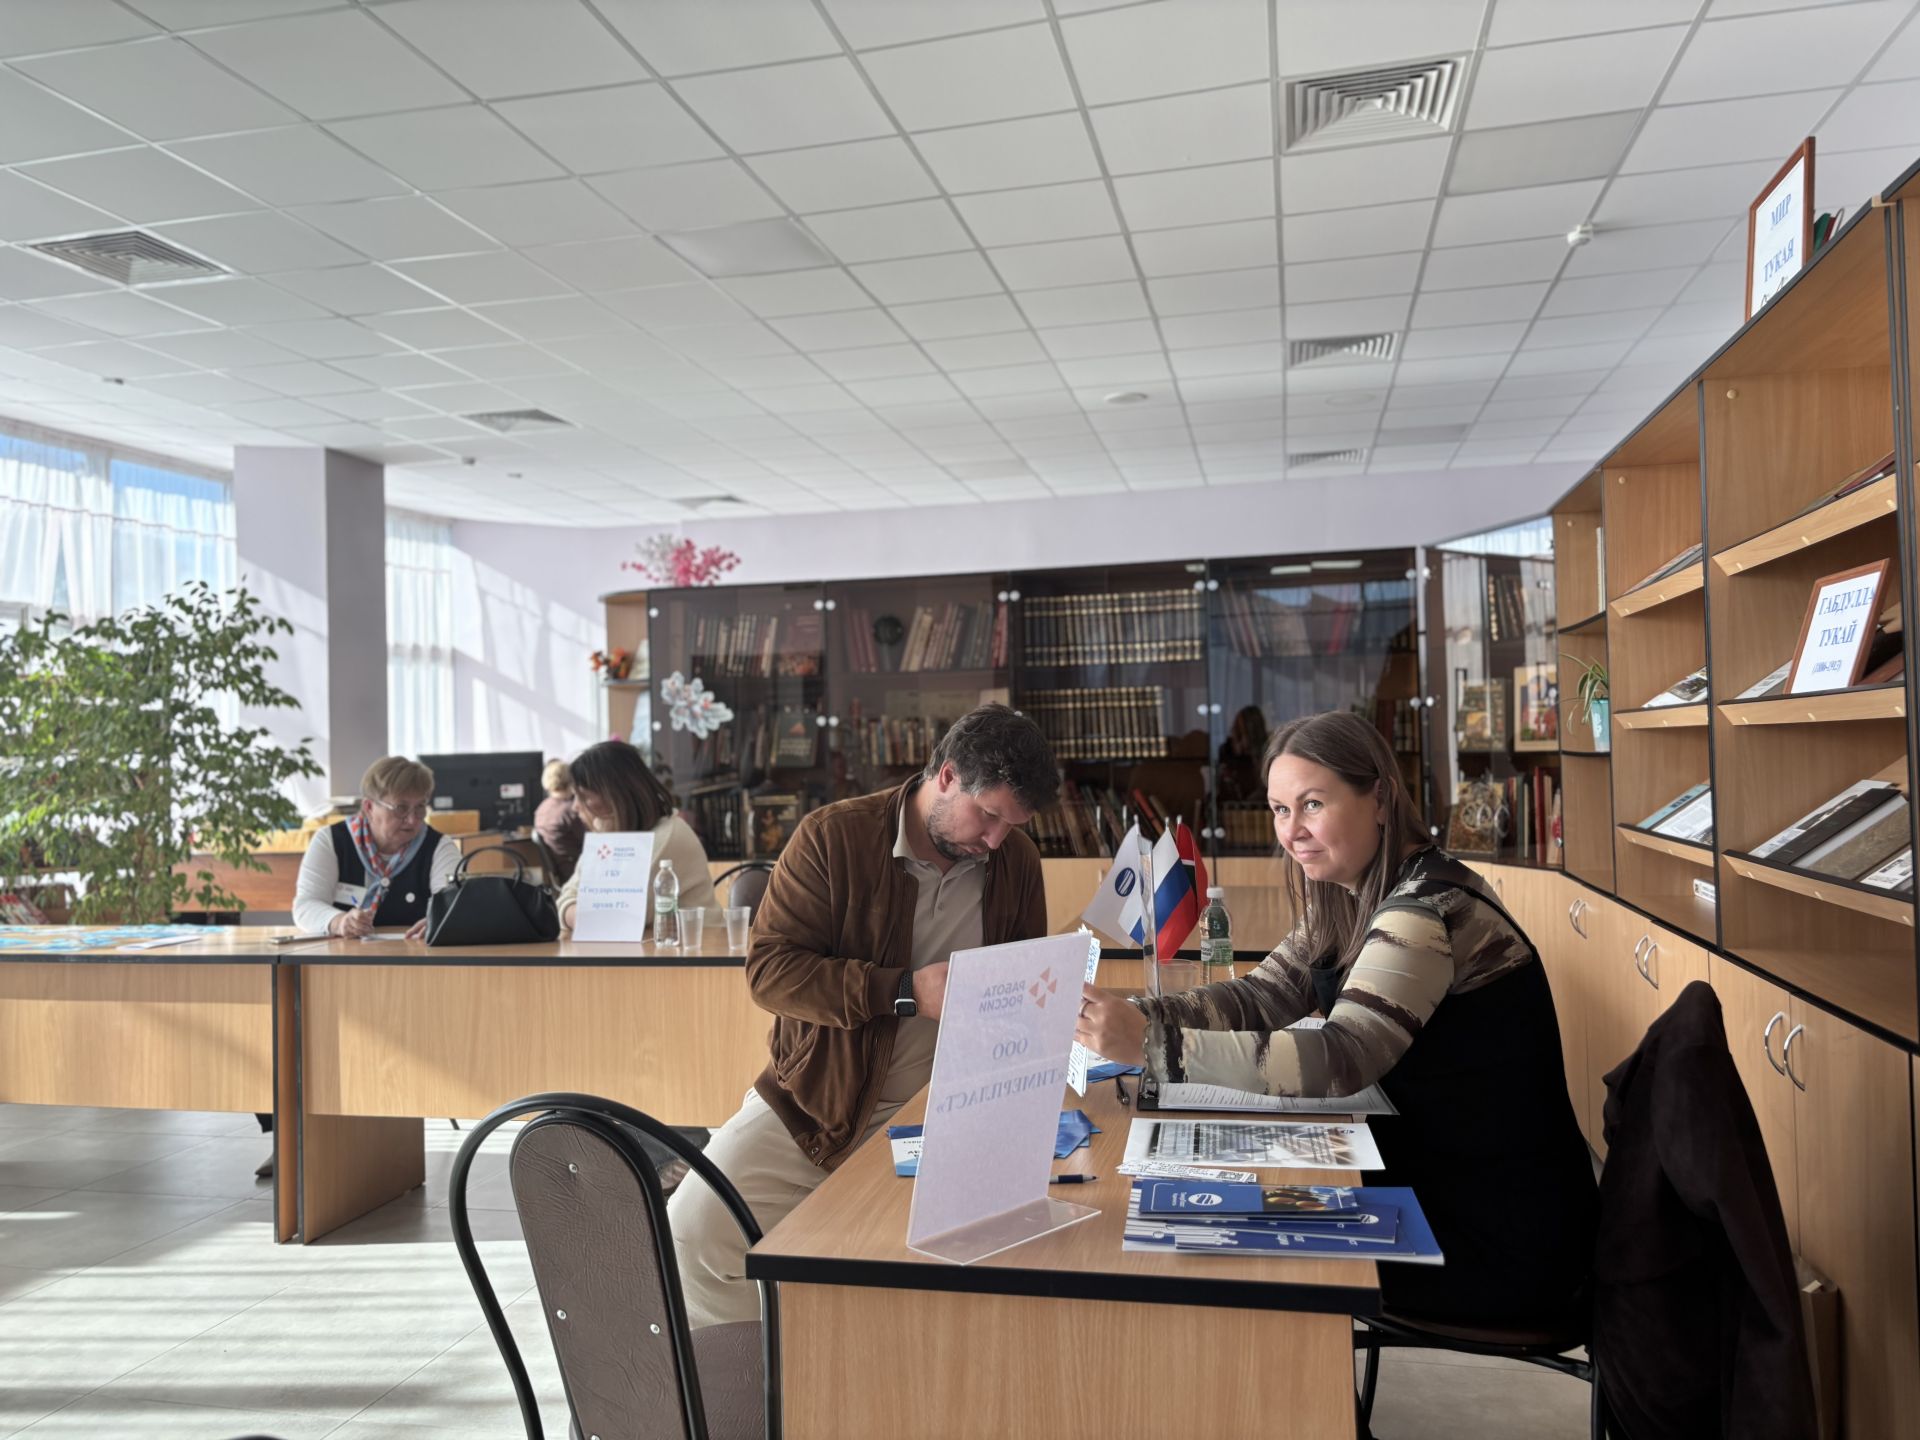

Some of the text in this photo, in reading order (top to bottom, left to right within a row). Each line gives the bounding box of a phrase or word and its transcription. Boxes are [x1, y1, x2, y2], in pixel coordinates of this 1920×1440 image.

[1771, 193, 1792, 226] МИР
[1764, 238, 1794, 282] ТУКАЯ
[1818, 619, 1858, 648] ТУКАЙ
